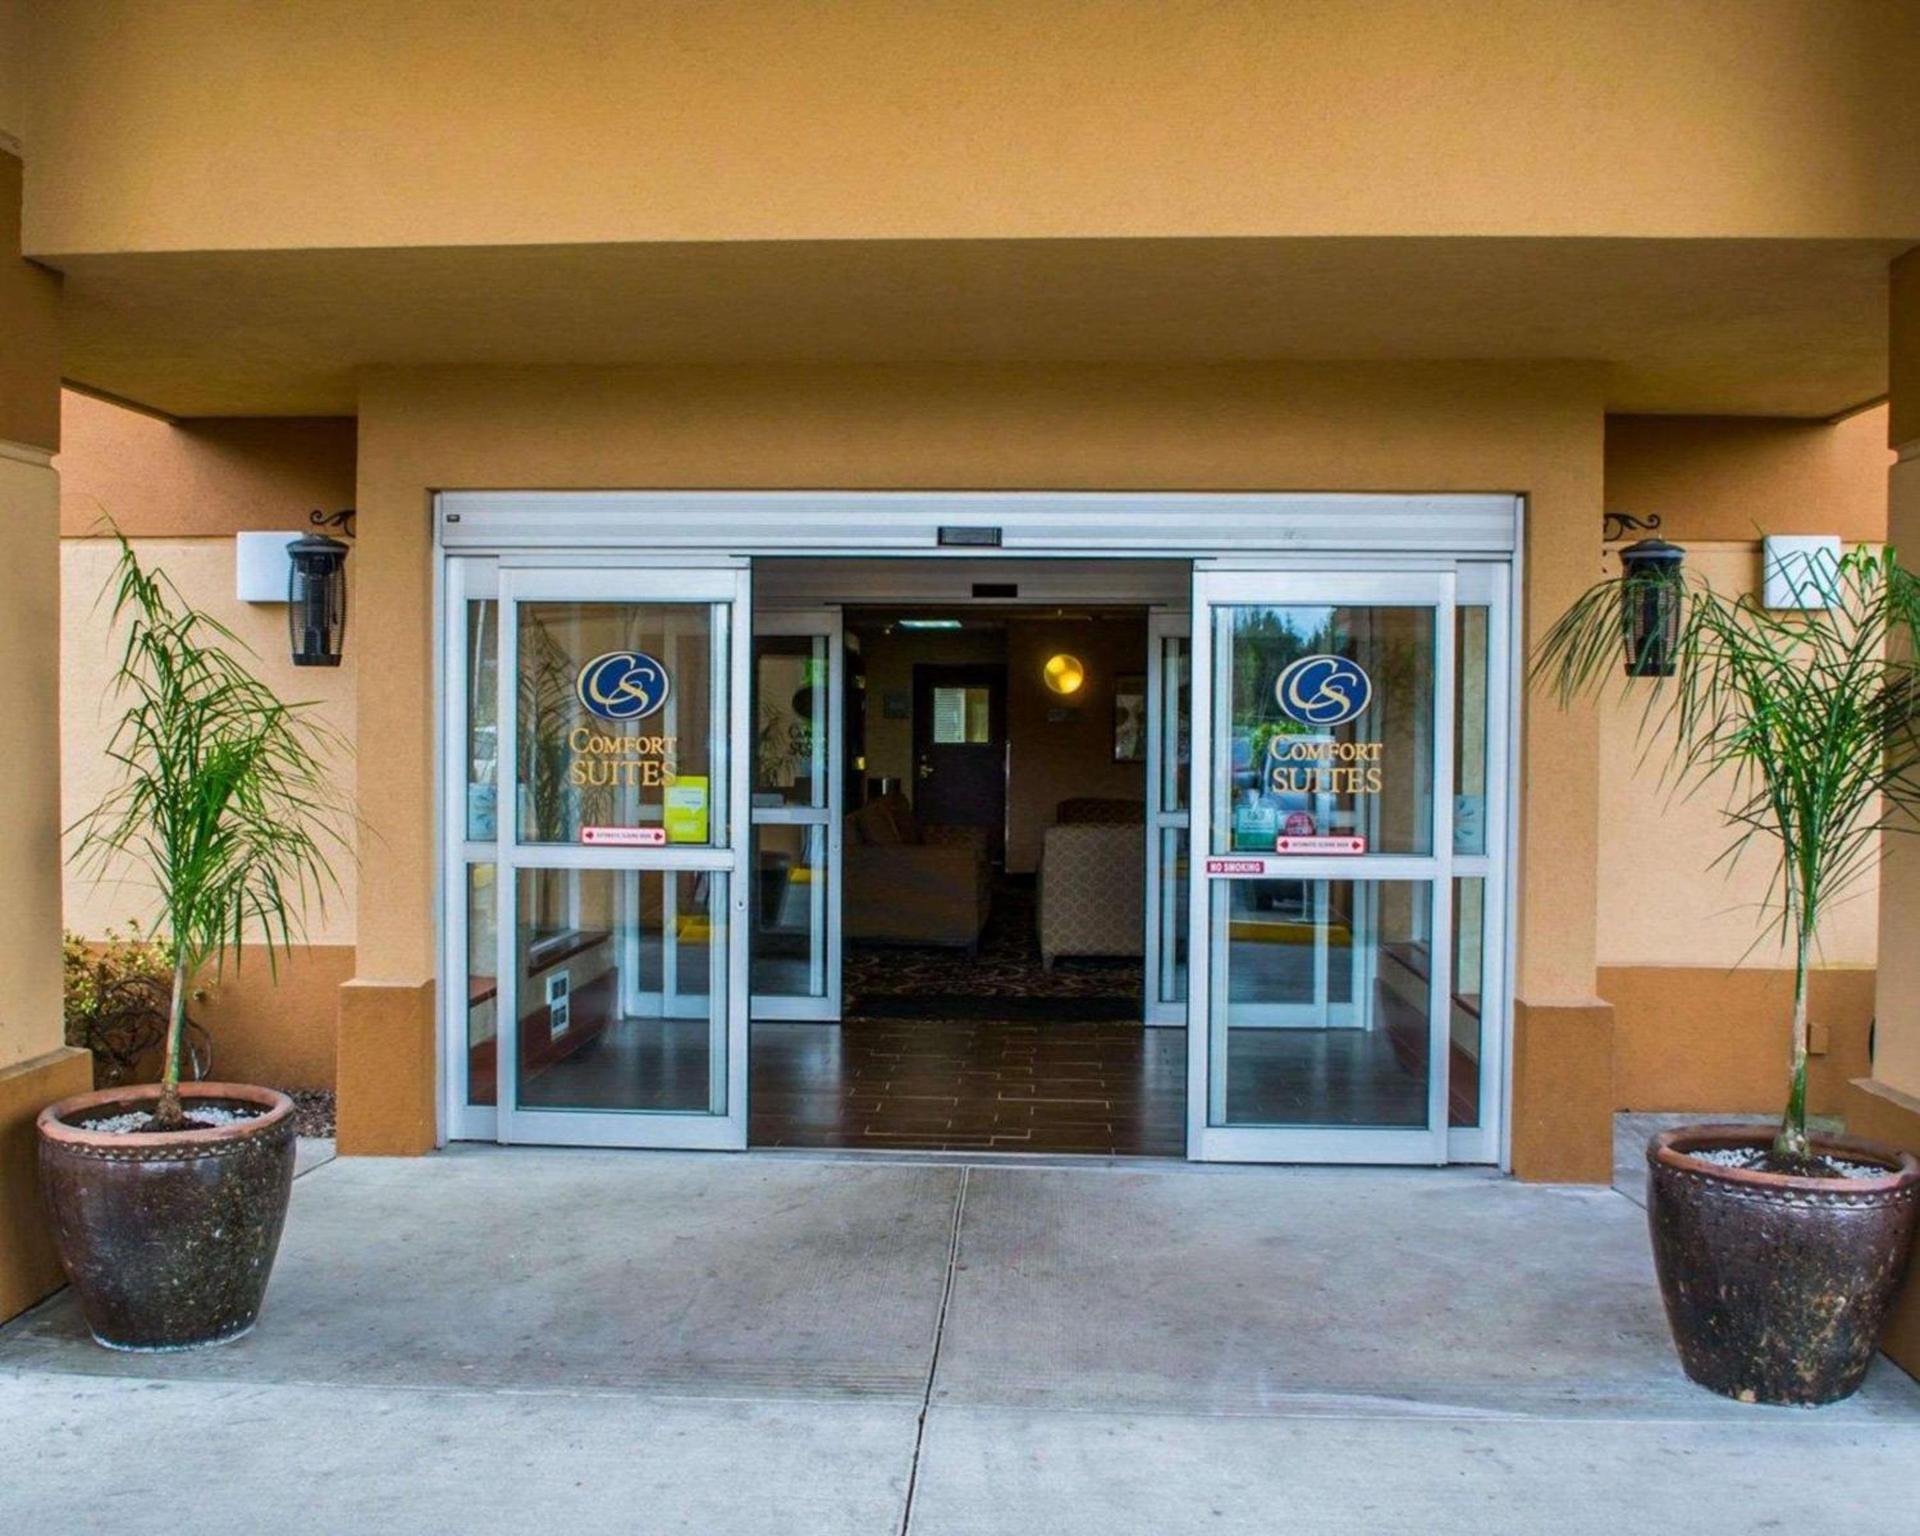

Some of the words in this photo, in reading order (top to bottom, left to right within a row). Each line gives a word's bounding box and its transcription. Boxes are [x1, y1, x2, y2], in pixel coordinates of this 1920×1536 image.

[569, 727, 677, 754] COMFORT
[1270, 734, 1383, 761] COMFORT
[570, 761, 677, 786] SUITES
[1272, 767, 1383, 793] SUITES
[1210, 862, 1222, 872] NO
[1224, 862, 1261, 873] SMOKING
